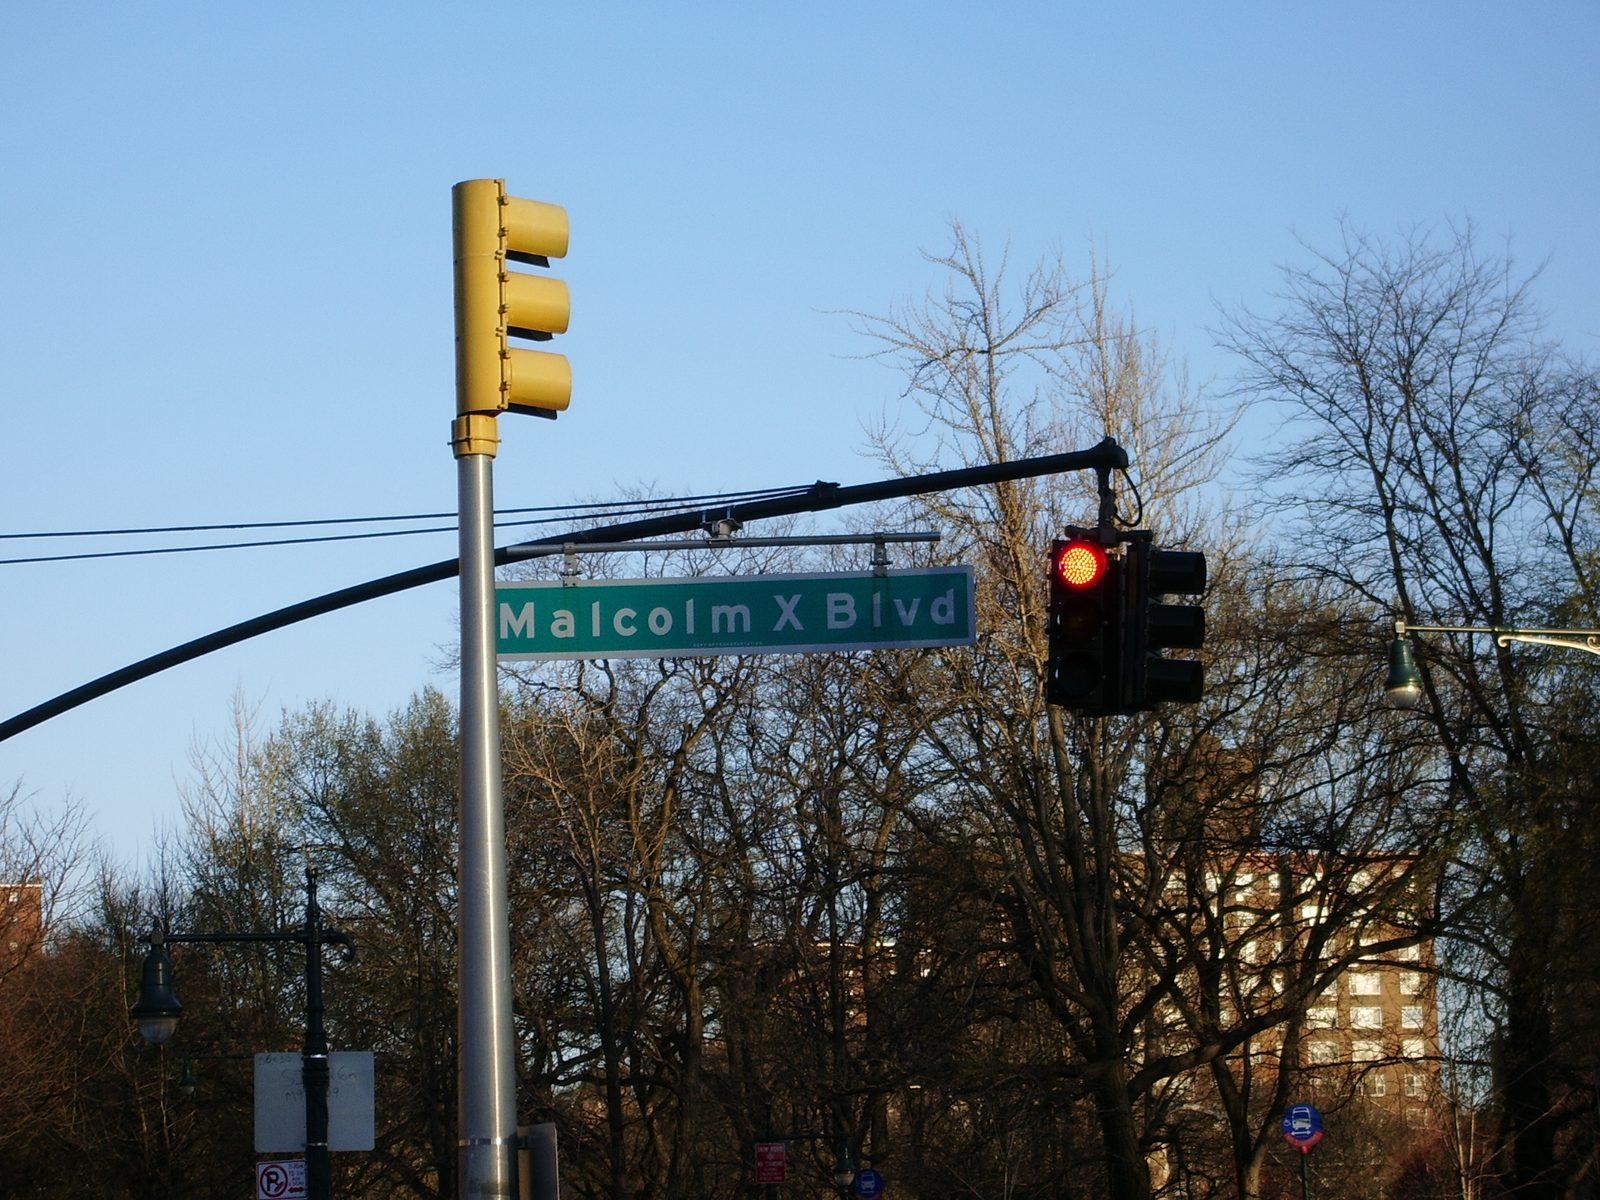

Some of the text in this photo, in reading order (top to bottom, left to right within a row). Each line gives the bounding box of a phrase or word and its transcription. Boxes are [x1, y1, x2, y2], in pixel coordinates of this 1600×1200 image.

[500, 588, 955, 639] Malcolm X Blvd
